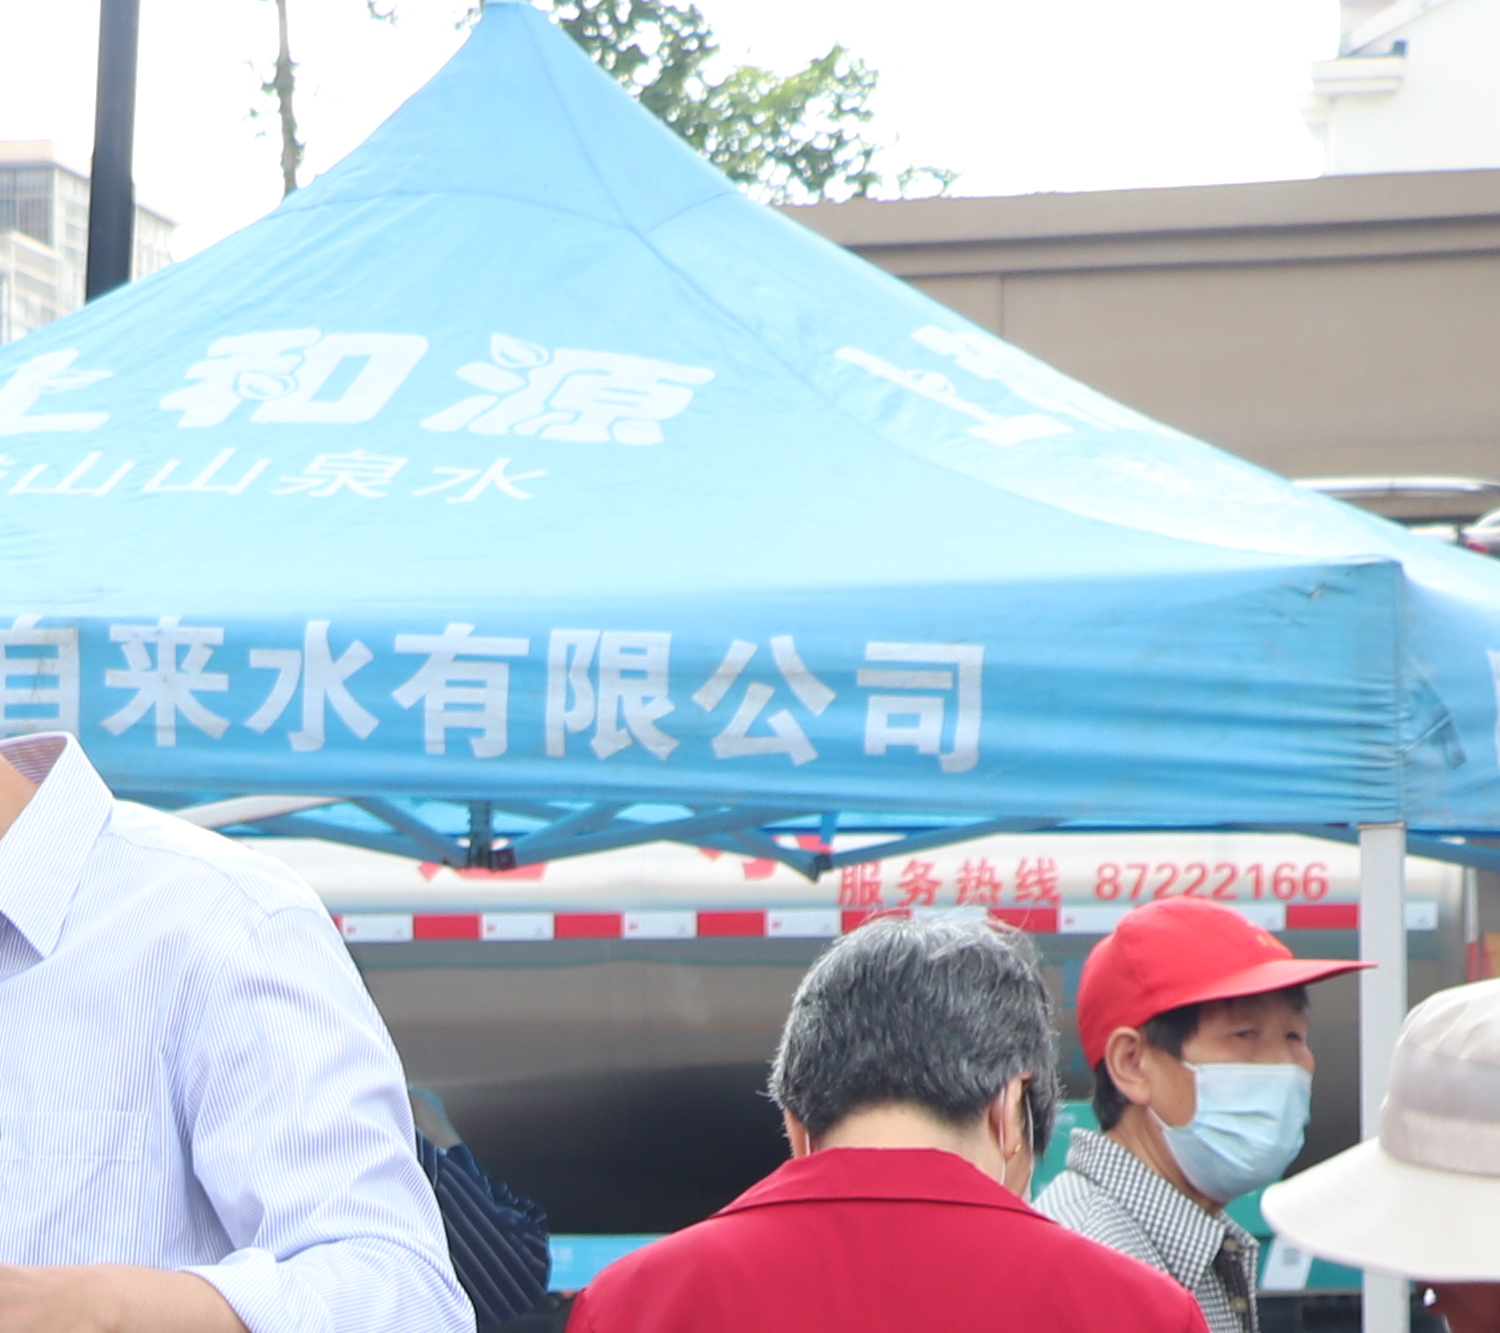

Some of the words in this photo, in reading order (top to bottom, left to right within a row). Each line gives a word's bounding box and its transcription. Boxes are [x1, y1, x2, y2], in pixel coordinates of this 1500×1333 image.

[837, 857, 1061, 907] 服务热线
[1095, 861, 1330, 904] 87222166
